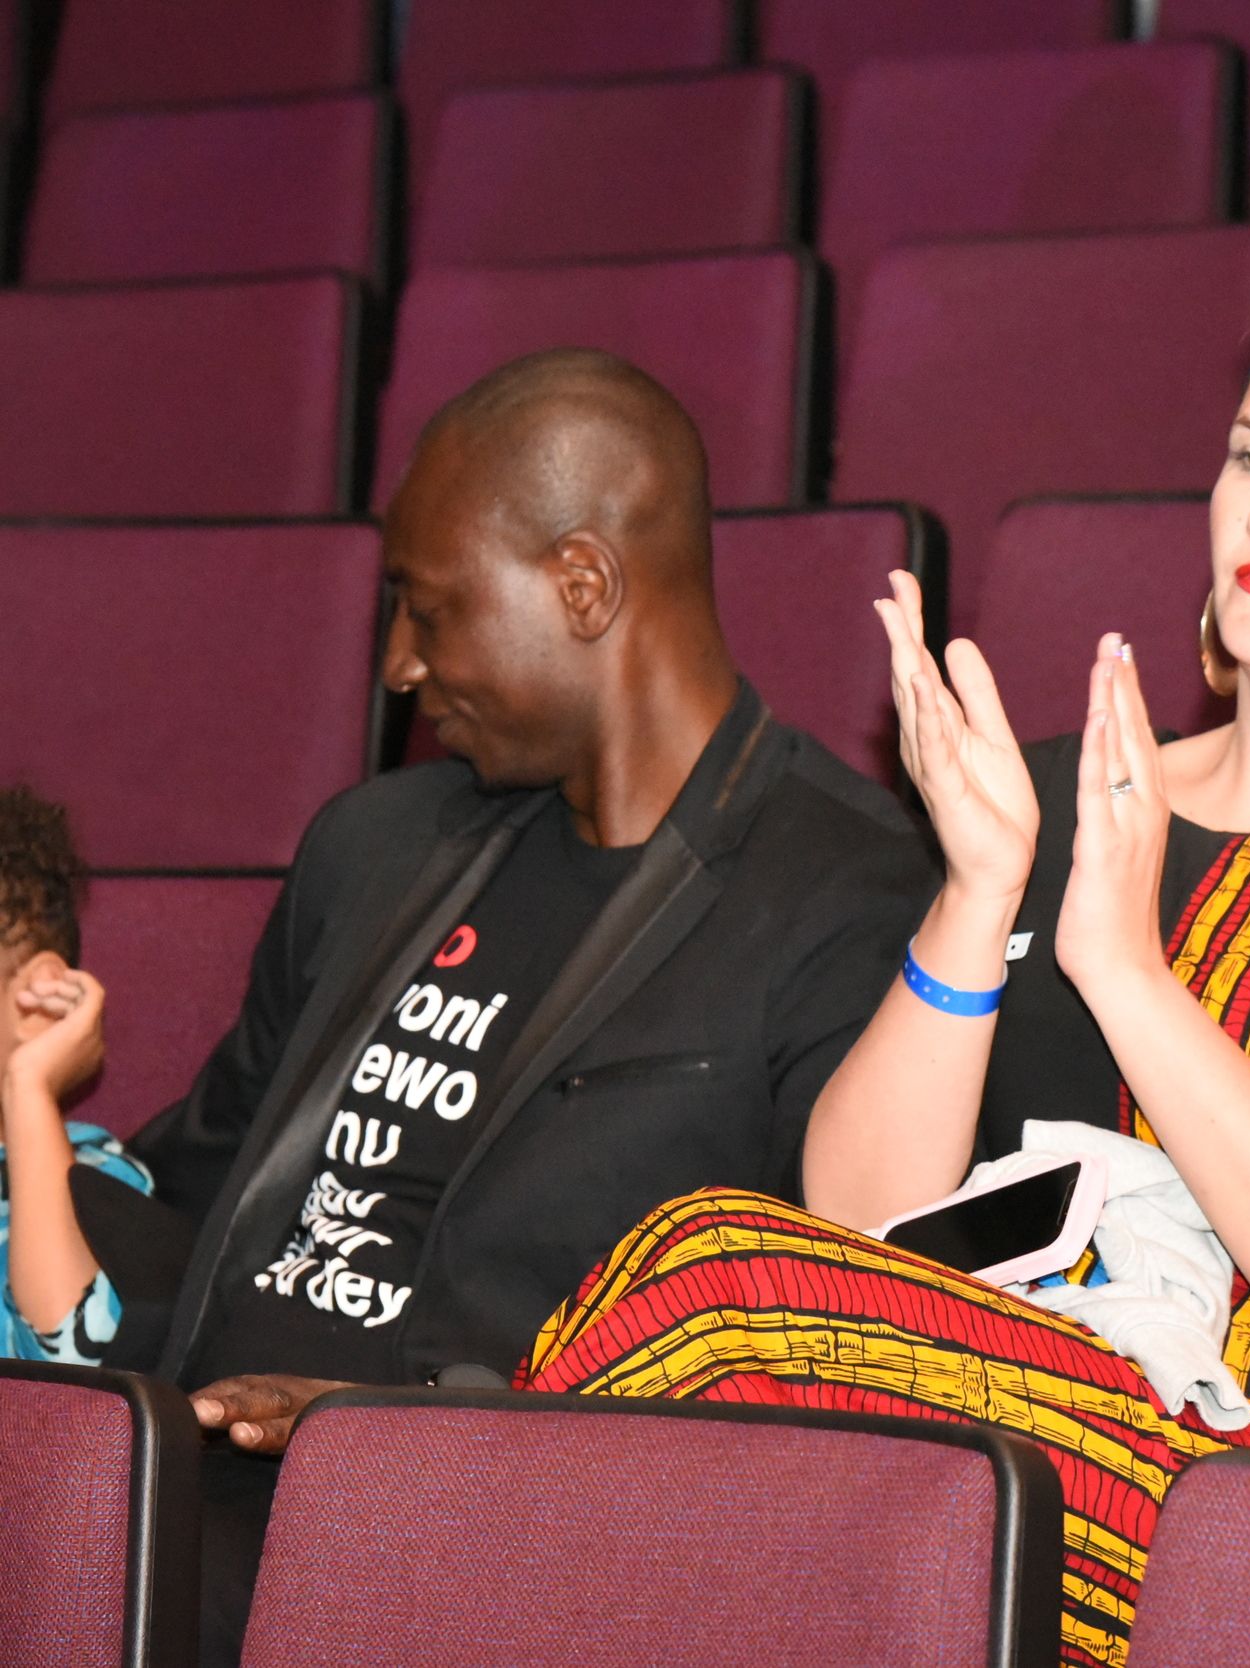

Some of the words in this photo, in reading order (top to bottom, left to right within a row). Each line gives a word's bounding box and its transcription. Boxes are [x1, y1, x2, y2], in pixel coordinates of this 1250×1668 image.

[352, 1043, 478, 1121] ewo
[325, 1109, 402, 1167] nu
[306, 1256, 412, 1328] dey
